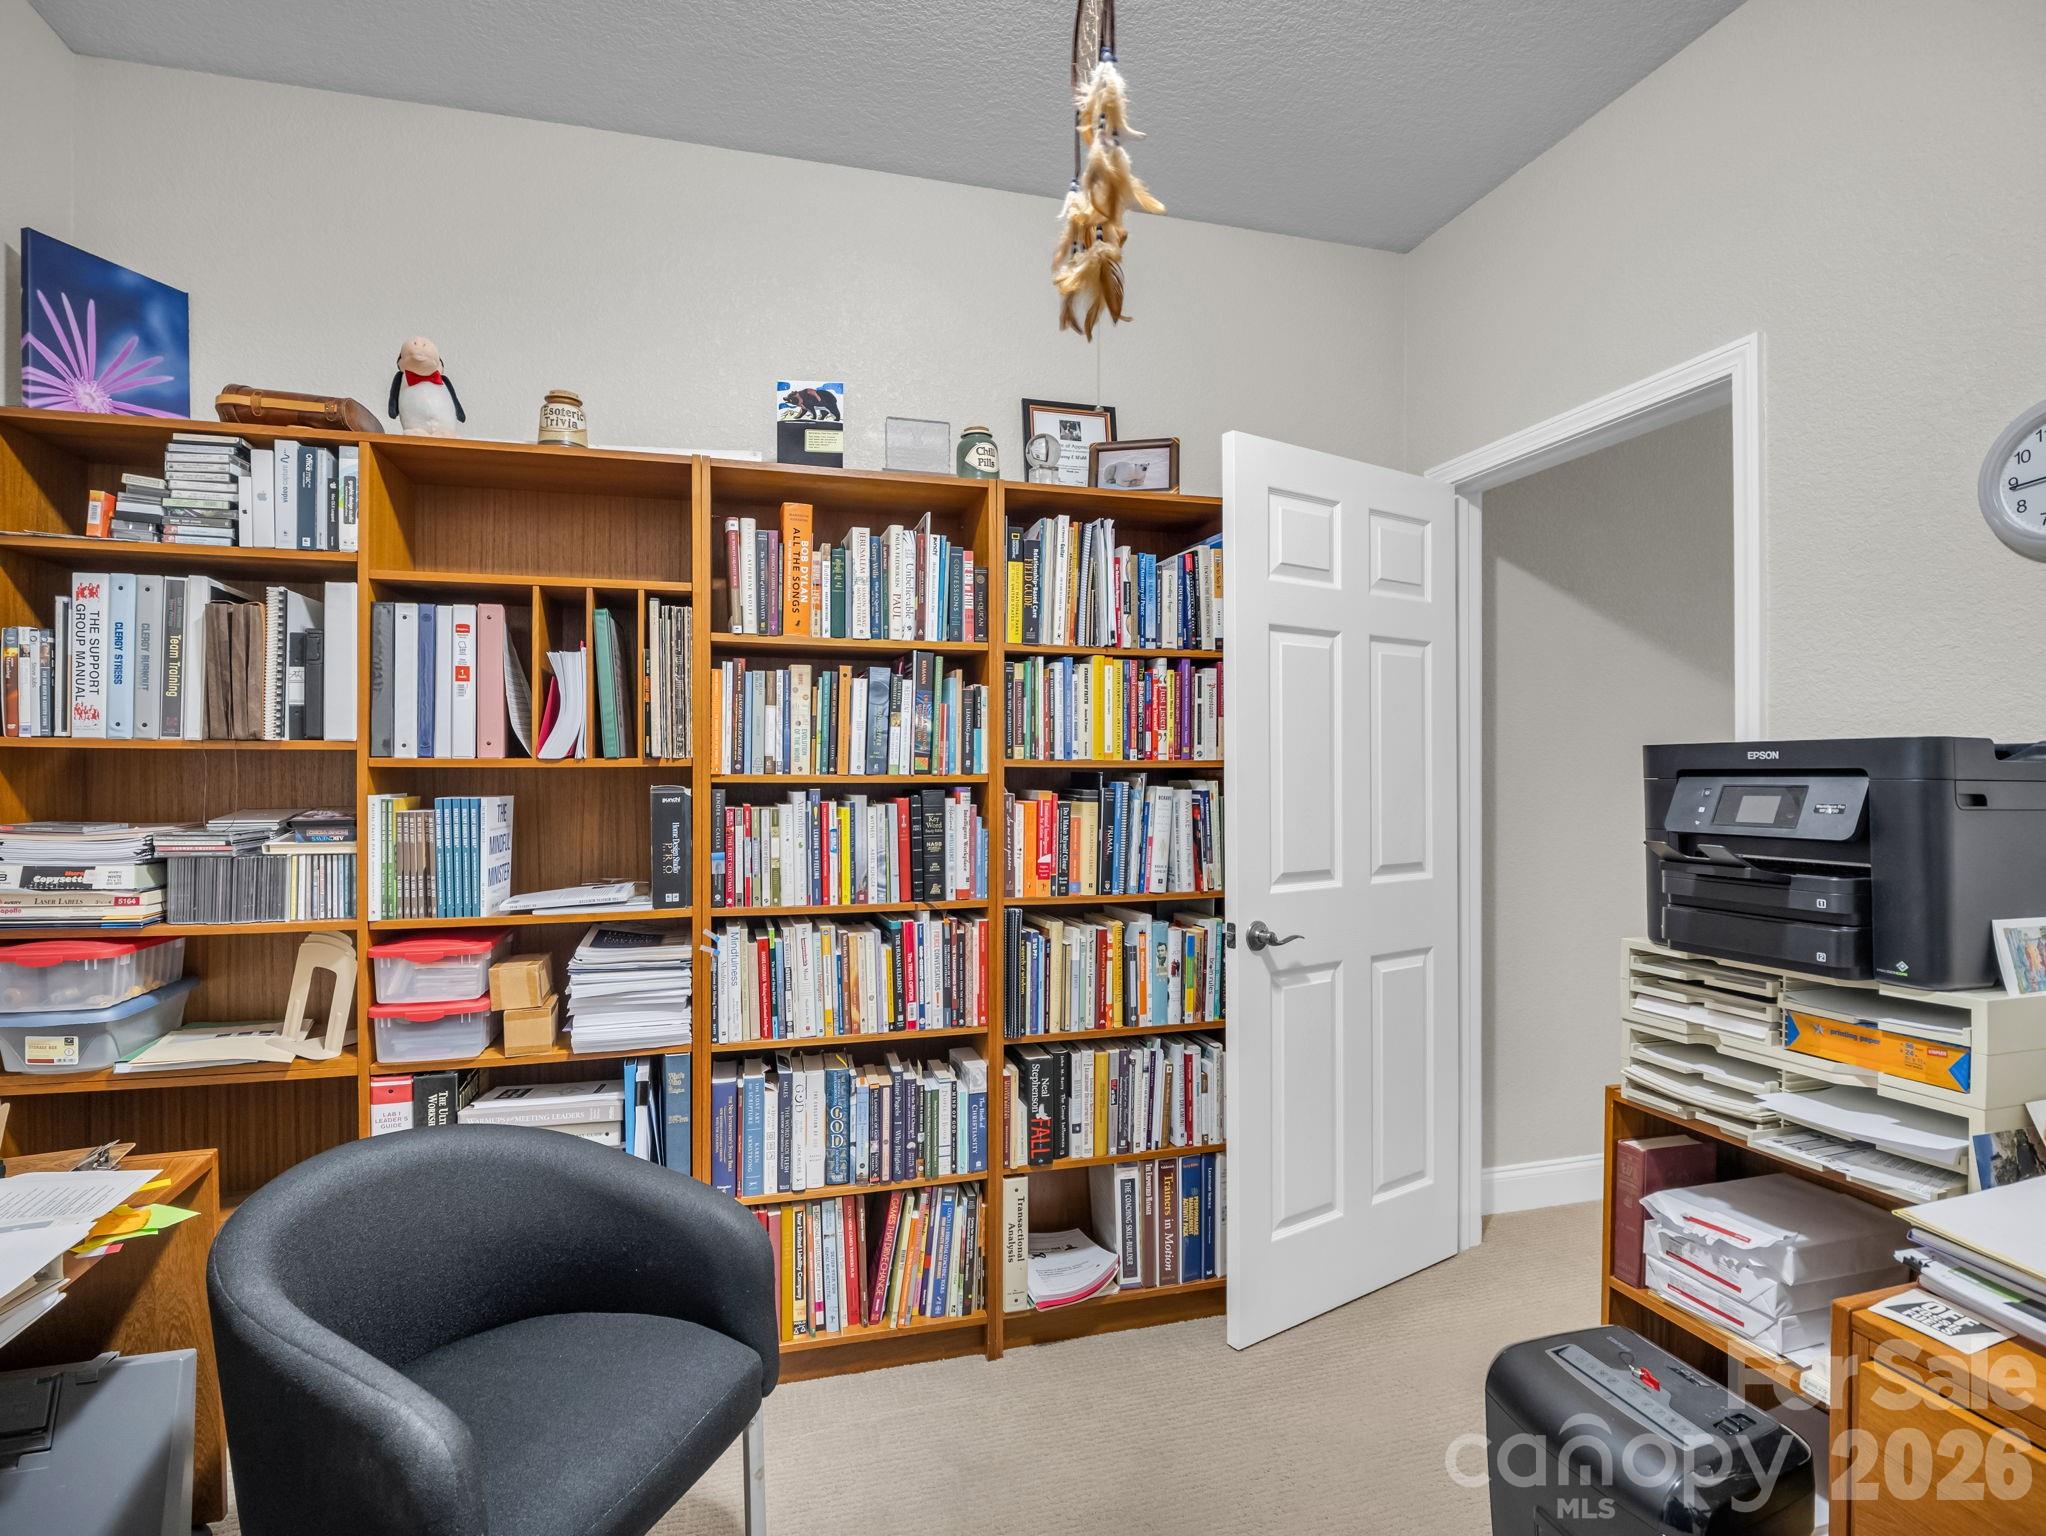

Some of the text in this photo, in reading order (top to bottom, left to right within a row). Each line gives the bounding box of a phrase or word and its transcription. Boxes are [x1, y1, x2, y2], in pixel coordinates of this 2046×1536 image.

[543, 404, 584, 422] Esoteric
[543, 417, 579, 430] Trivia
[2014, 449, 2031, 464] 10
[2016, 499, 2027, 514] 8
[792, 527, 801, 614] ALL THE SONGS
[801, 540, 809, 603] BOB DYLAN
[892, 593, 901, 620] PAUL
[75, 603, 86, 701] GROUP MANUAL
[89, 610, 100, 695] THE SUPPORT
[113, 622, 124, 685] CLERGY STRESS
[141, 623, 150, 653] CLERGY
[165, 634, 182, 697] Team Training
[1747, 750, 1780, 760] EPSON
[32, 875, 85, 885] Copysett
[730, 932, 740, 987] Mindfulness
[1030, 1063, 1040, 1113] Stephenson
[1041, 1078, 1050, 1097] Neal
[427, 1093, 438, 1127] WORKSH
[438, 1107, 449, 1125] ULTI
[830, 1105, 844, 1149] GOD
[1163, 1172, 1174, 1216] Trainers
[1006, 1222, 1016, 1263] Analysis
[1016, 1196, 1025, 1262] Transactional
[1164, 1232, 1174, 1272] Motion
